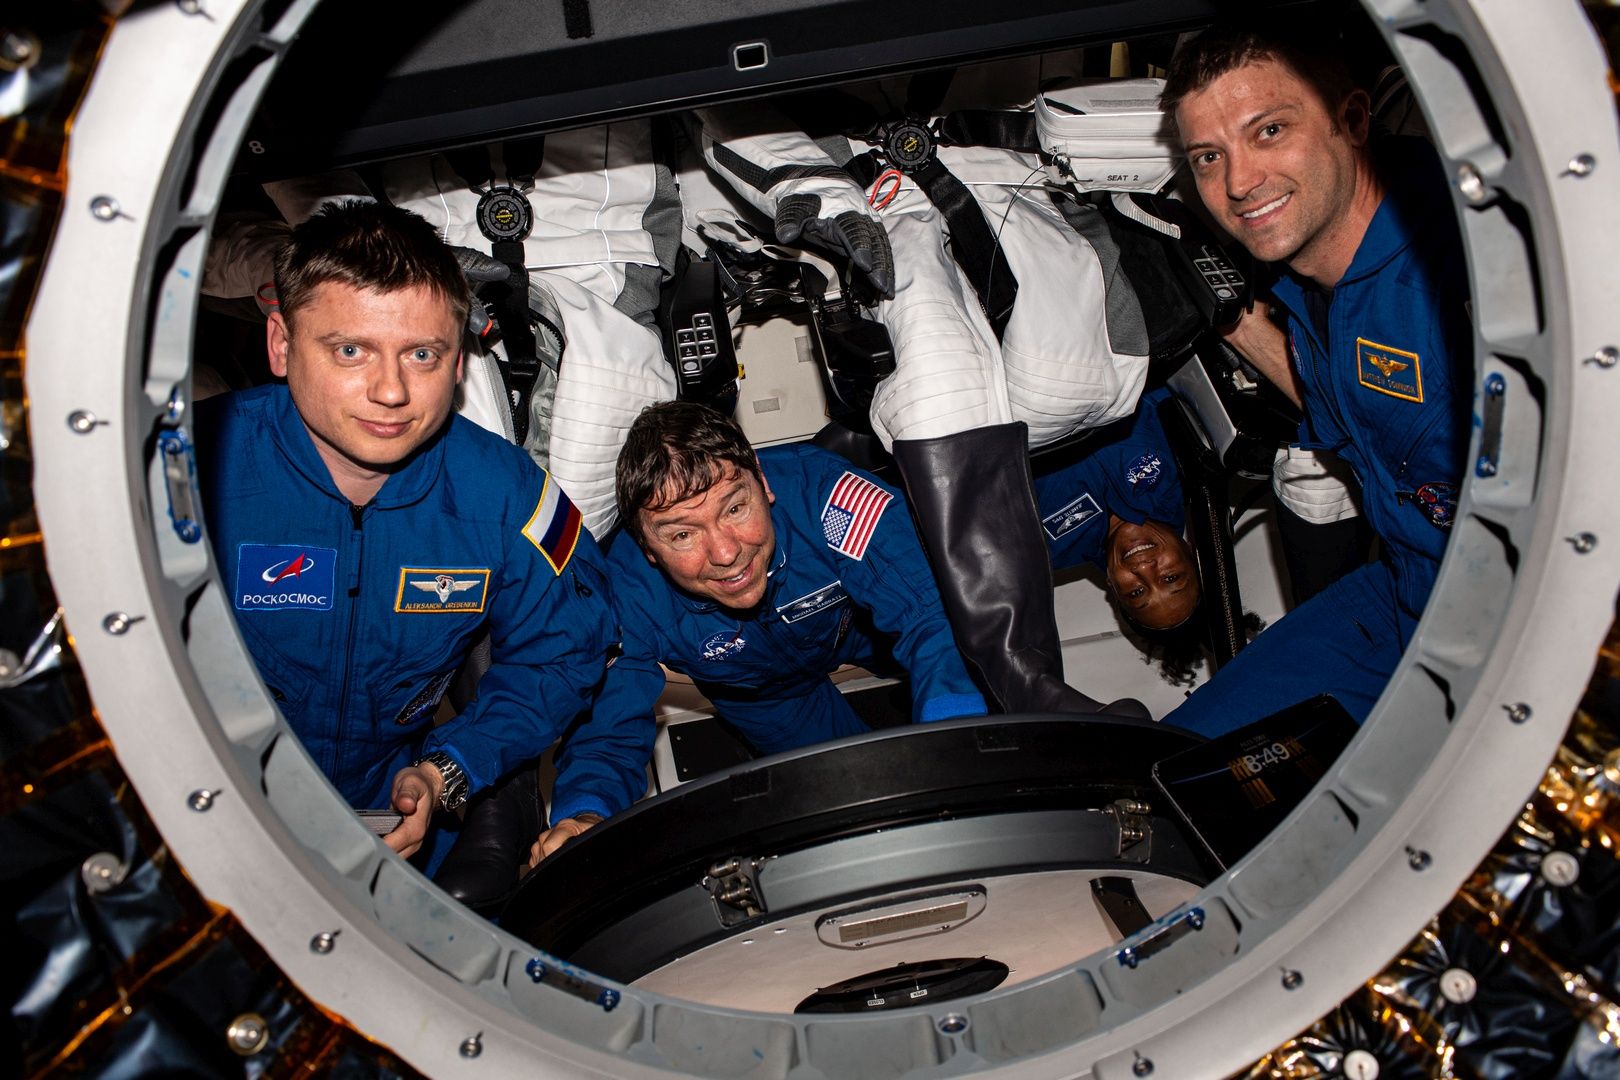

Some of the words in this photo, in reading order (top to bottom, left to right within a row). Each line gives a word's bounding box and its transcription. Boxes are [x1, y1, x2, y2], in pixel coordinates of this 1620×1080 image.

[248, 140, 265, 154] 8
[1107, 174, 1129, 182] SEAT
[1132, 174, 1139, 182] 2
[1127, 457, 1161, 484] NASA
[242, 593, 327, 605] РОСКОСМОС
[703, 637, 746, 659] NASA
[1244, 742, 1291, 773] 8:49
